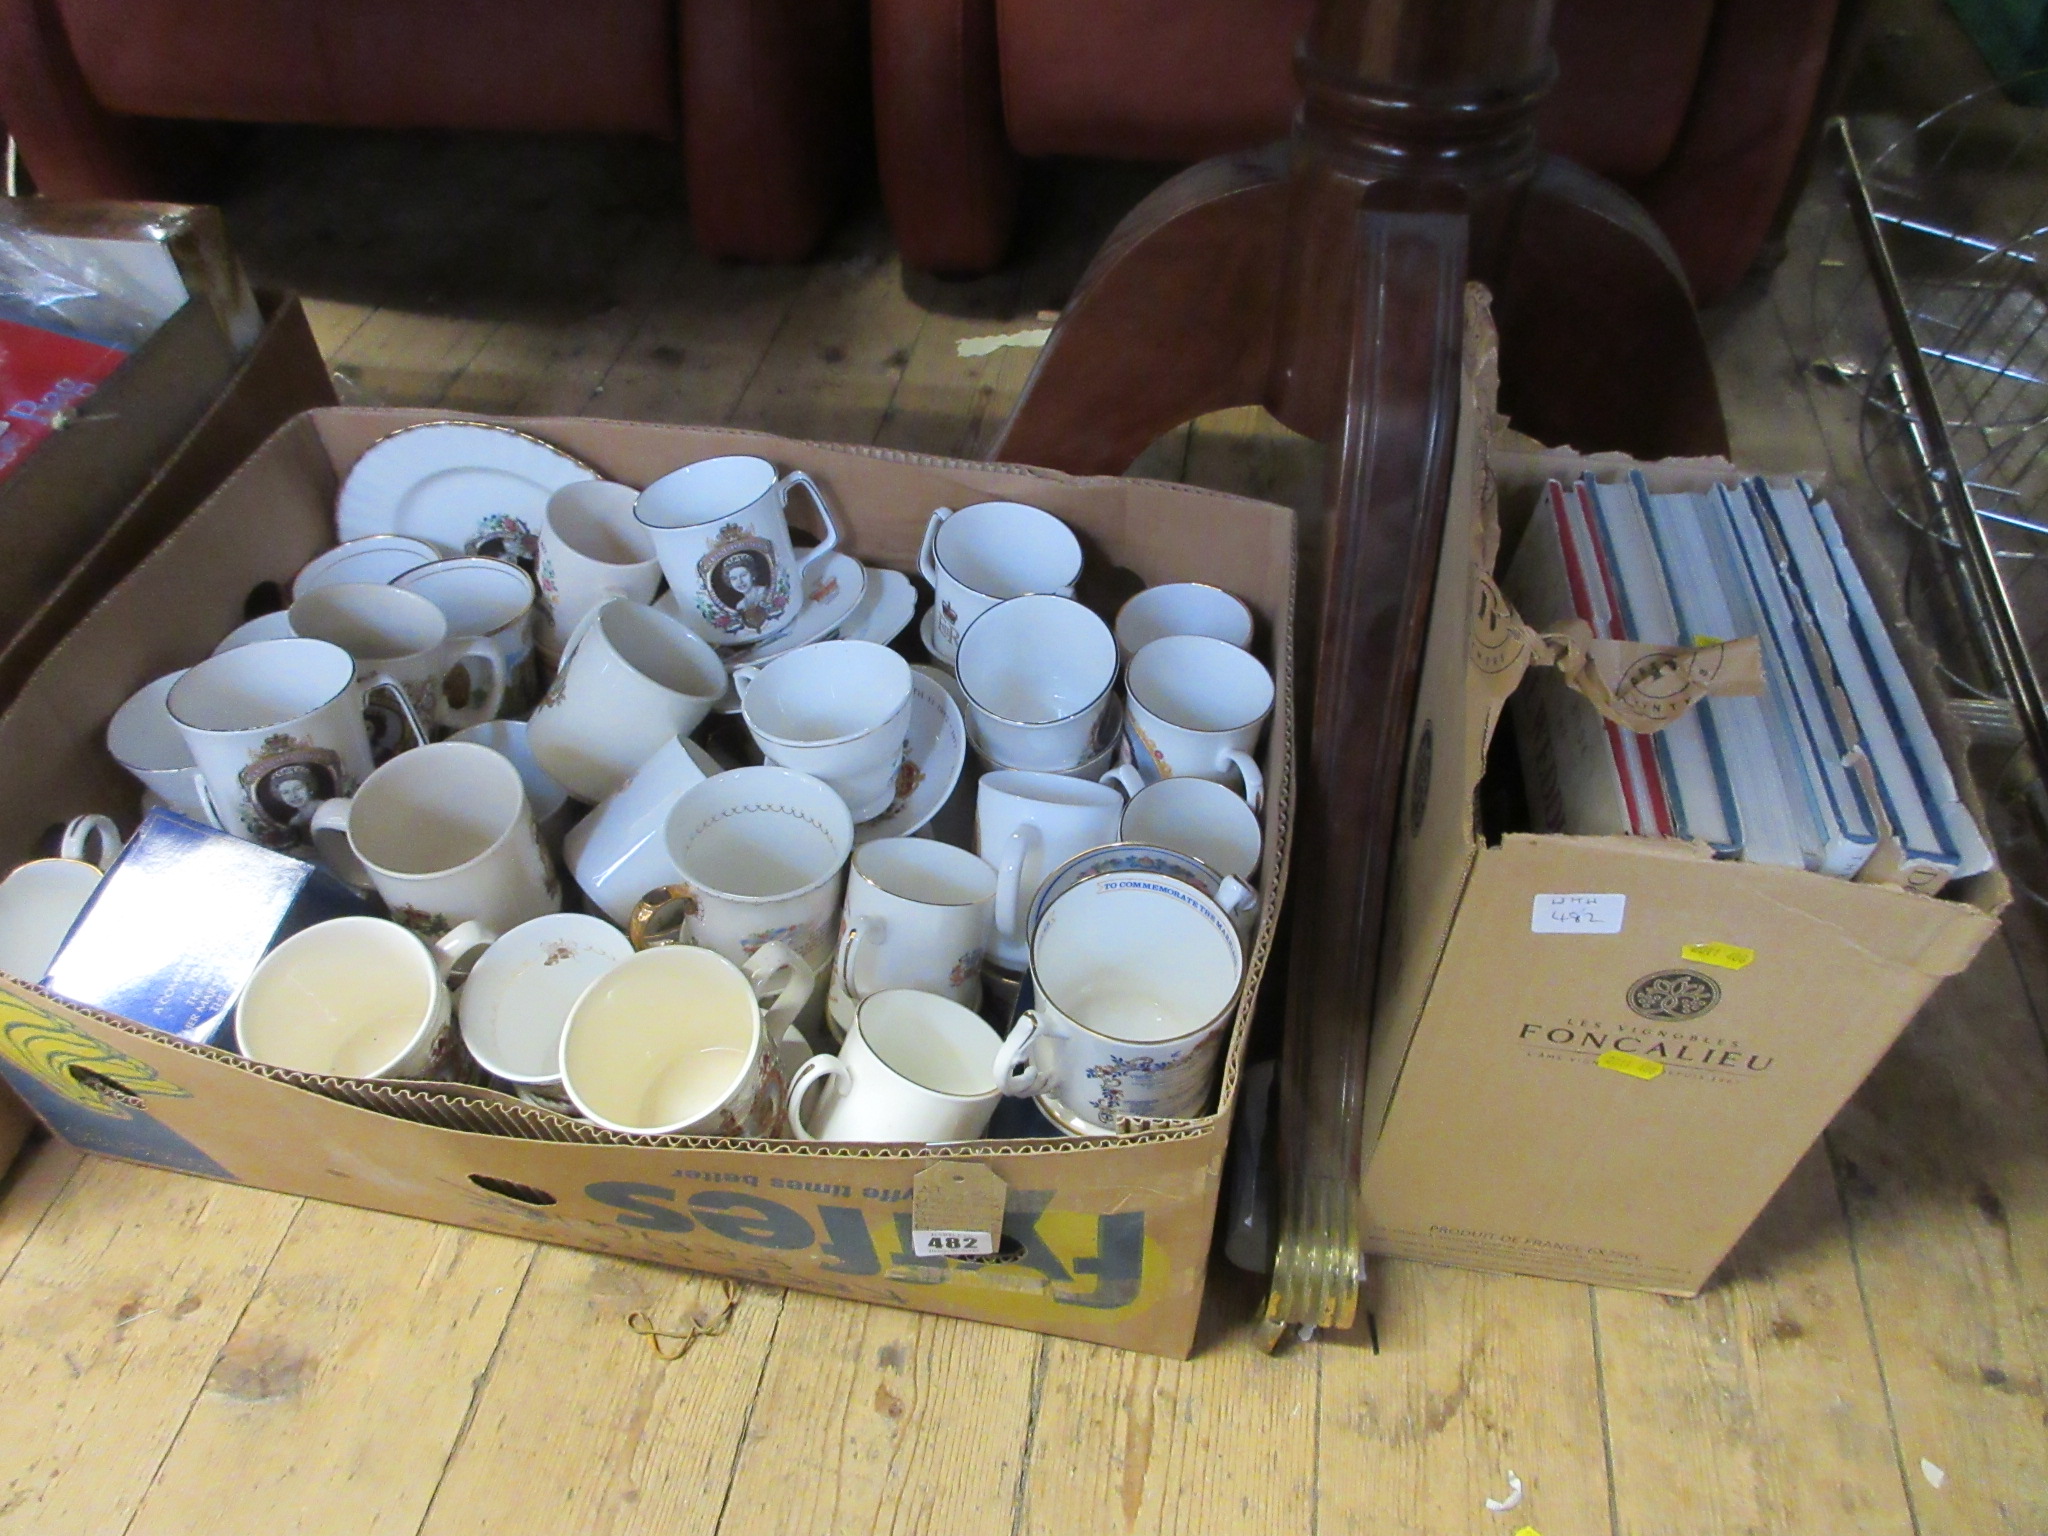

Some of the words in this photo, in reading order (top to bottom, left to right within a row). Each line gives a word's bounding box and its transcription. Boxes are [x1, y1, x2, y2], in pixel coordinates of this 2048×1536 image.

[1104, 881, 1117, 890] TO
[1119, 881, 1199, 908] COMMEMORATE
[1199, 904, 1217, 922] THE
[1551, 911, 1606, 923] 482
[1567, 1018, 1602, 1028] LES
[1617, 1024, 1740, 1048] VIGNOBLES
[1518, 1022, 1775, 1072] FONCALIEU
[672, 1169, 759, 1187] better
[771, 1178, 851, 1198] times
[863, 1187, 914, 1203] yffe
[928, 1237, 978, 1249] 482
